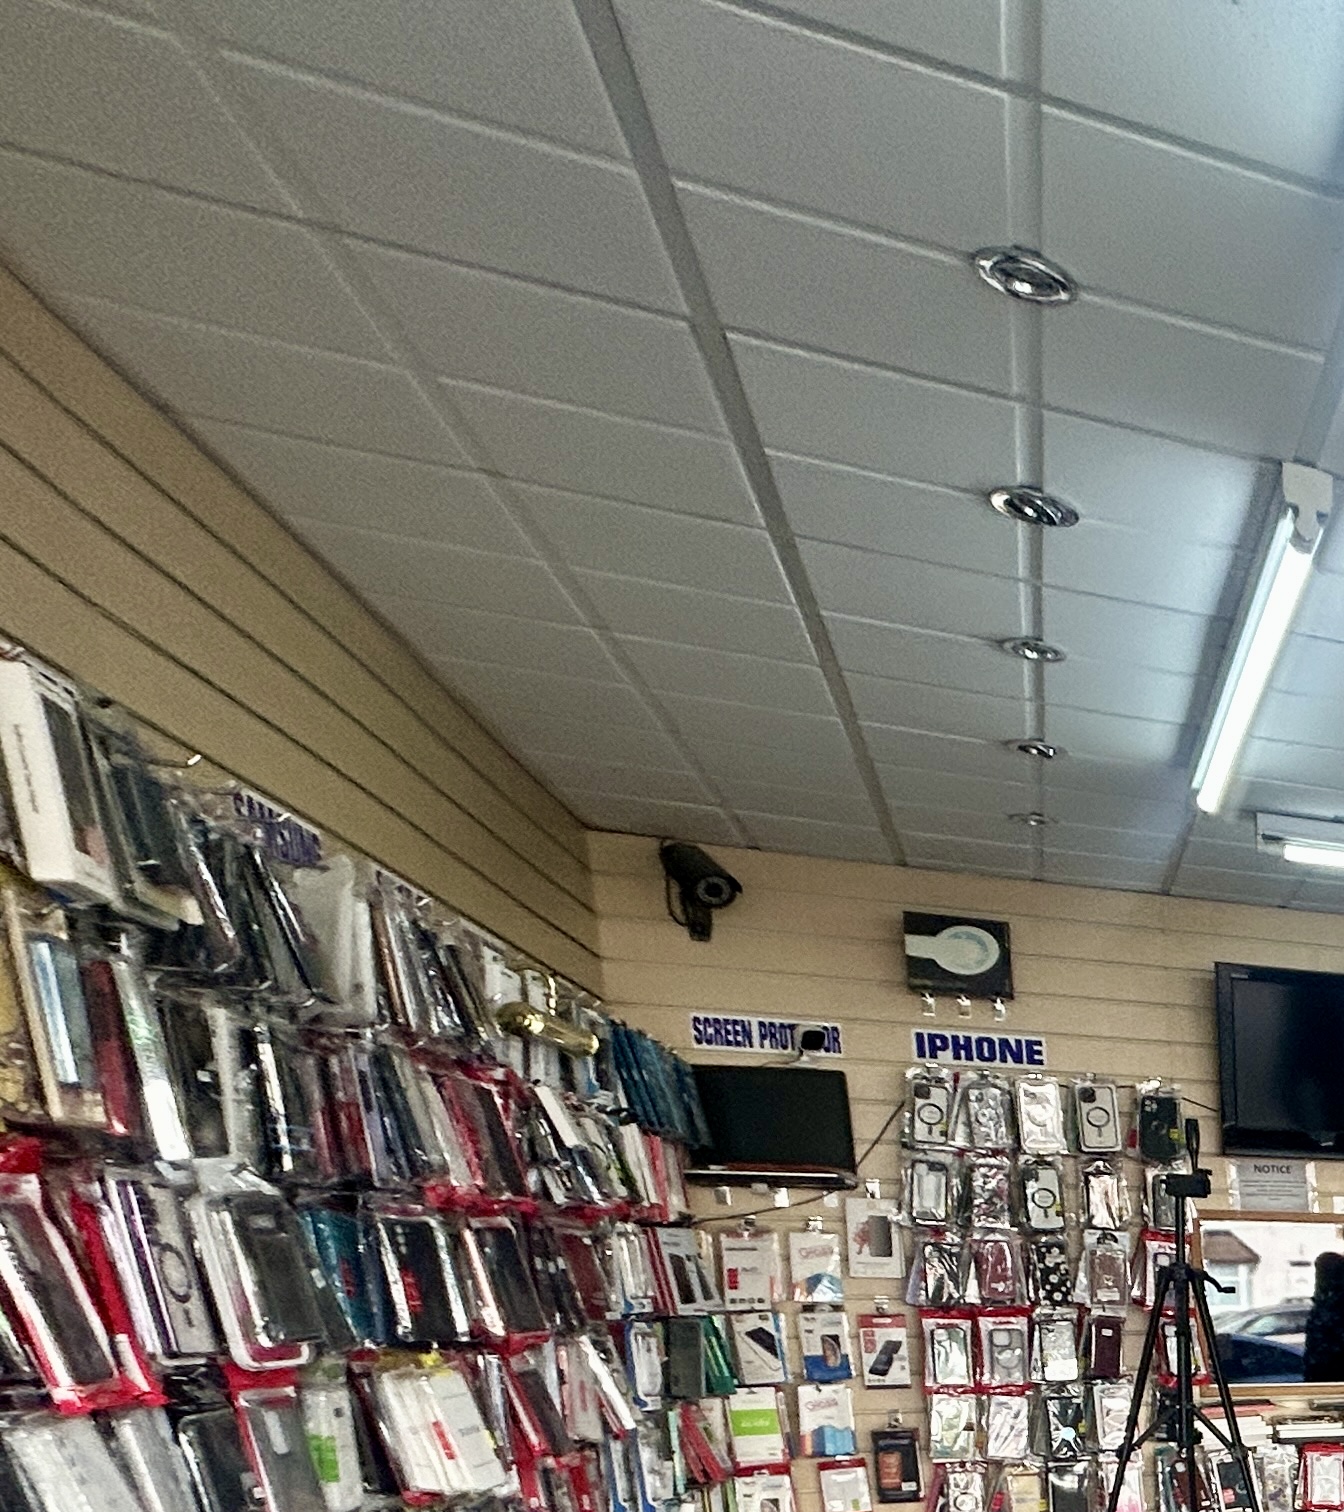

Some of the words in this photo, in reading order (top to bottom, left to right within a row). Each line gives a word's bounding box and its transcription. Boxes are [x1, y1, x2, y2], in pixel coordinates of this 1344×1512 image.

[692, 1016, 754, 1048] SCREEN
[758, 1021, 842, 1054] PROTOR
[915, 1032, 1044, 1065] IPHONE
[1254, 1164, 1291, 1174] NOTICE
